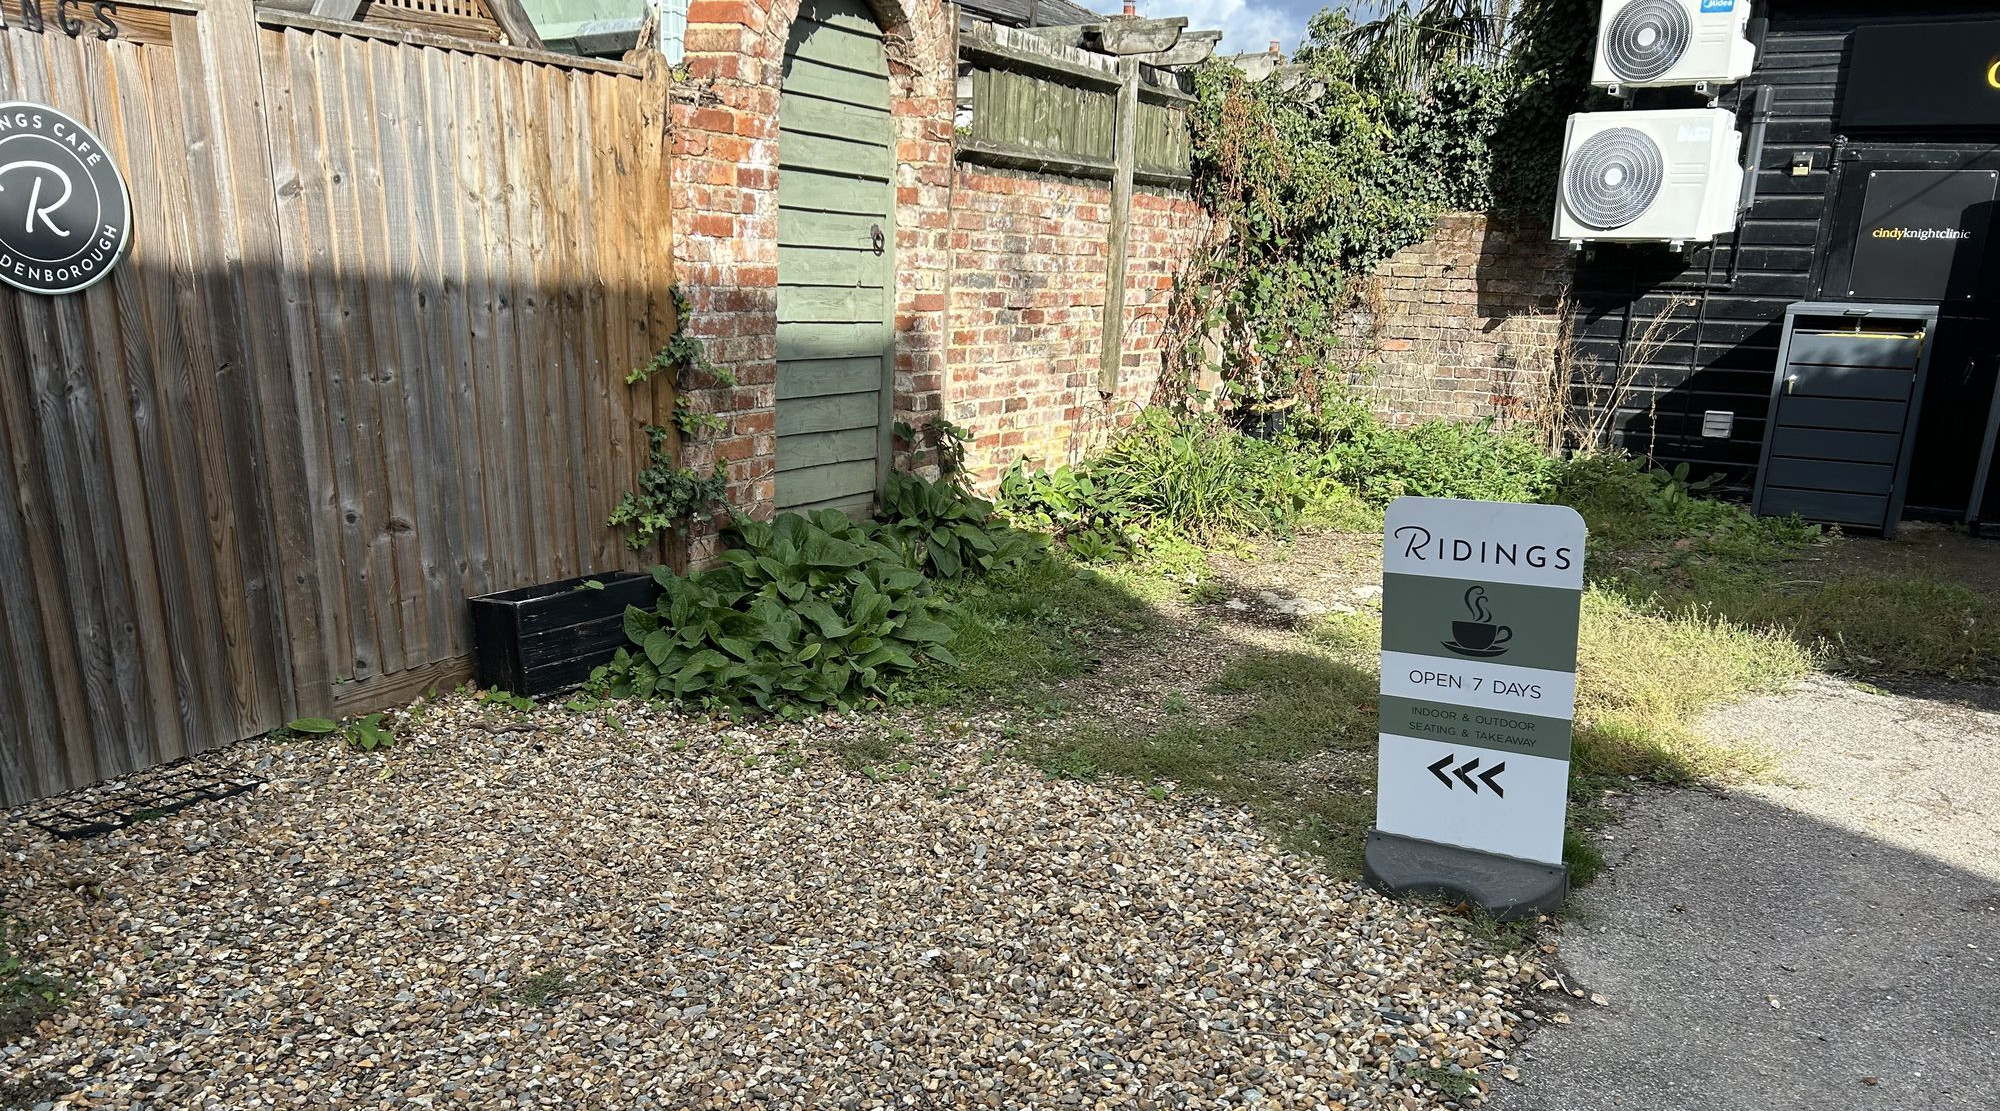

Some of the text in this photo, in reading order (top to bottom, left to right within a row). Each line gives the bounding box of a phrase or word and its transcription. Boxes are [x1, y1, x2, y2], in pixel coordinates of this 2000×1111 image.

[53, 122, 101, 167] CAFÉ
[0, 160, 72, 237] R
[1872, 227, 1971, 241] cindyknightclinic
[0, 224, 117, 282] DENBOROUGH
[1394, 526, 1571, 570] RIDINGS
[1409, 669, 1542, 699] OPEN 7 DAYS
[1409, 721, 1537, 748] SEATING & TAKEAWAY
[1411, 706, 1536, 732] INDOOR & OUTDOOR
